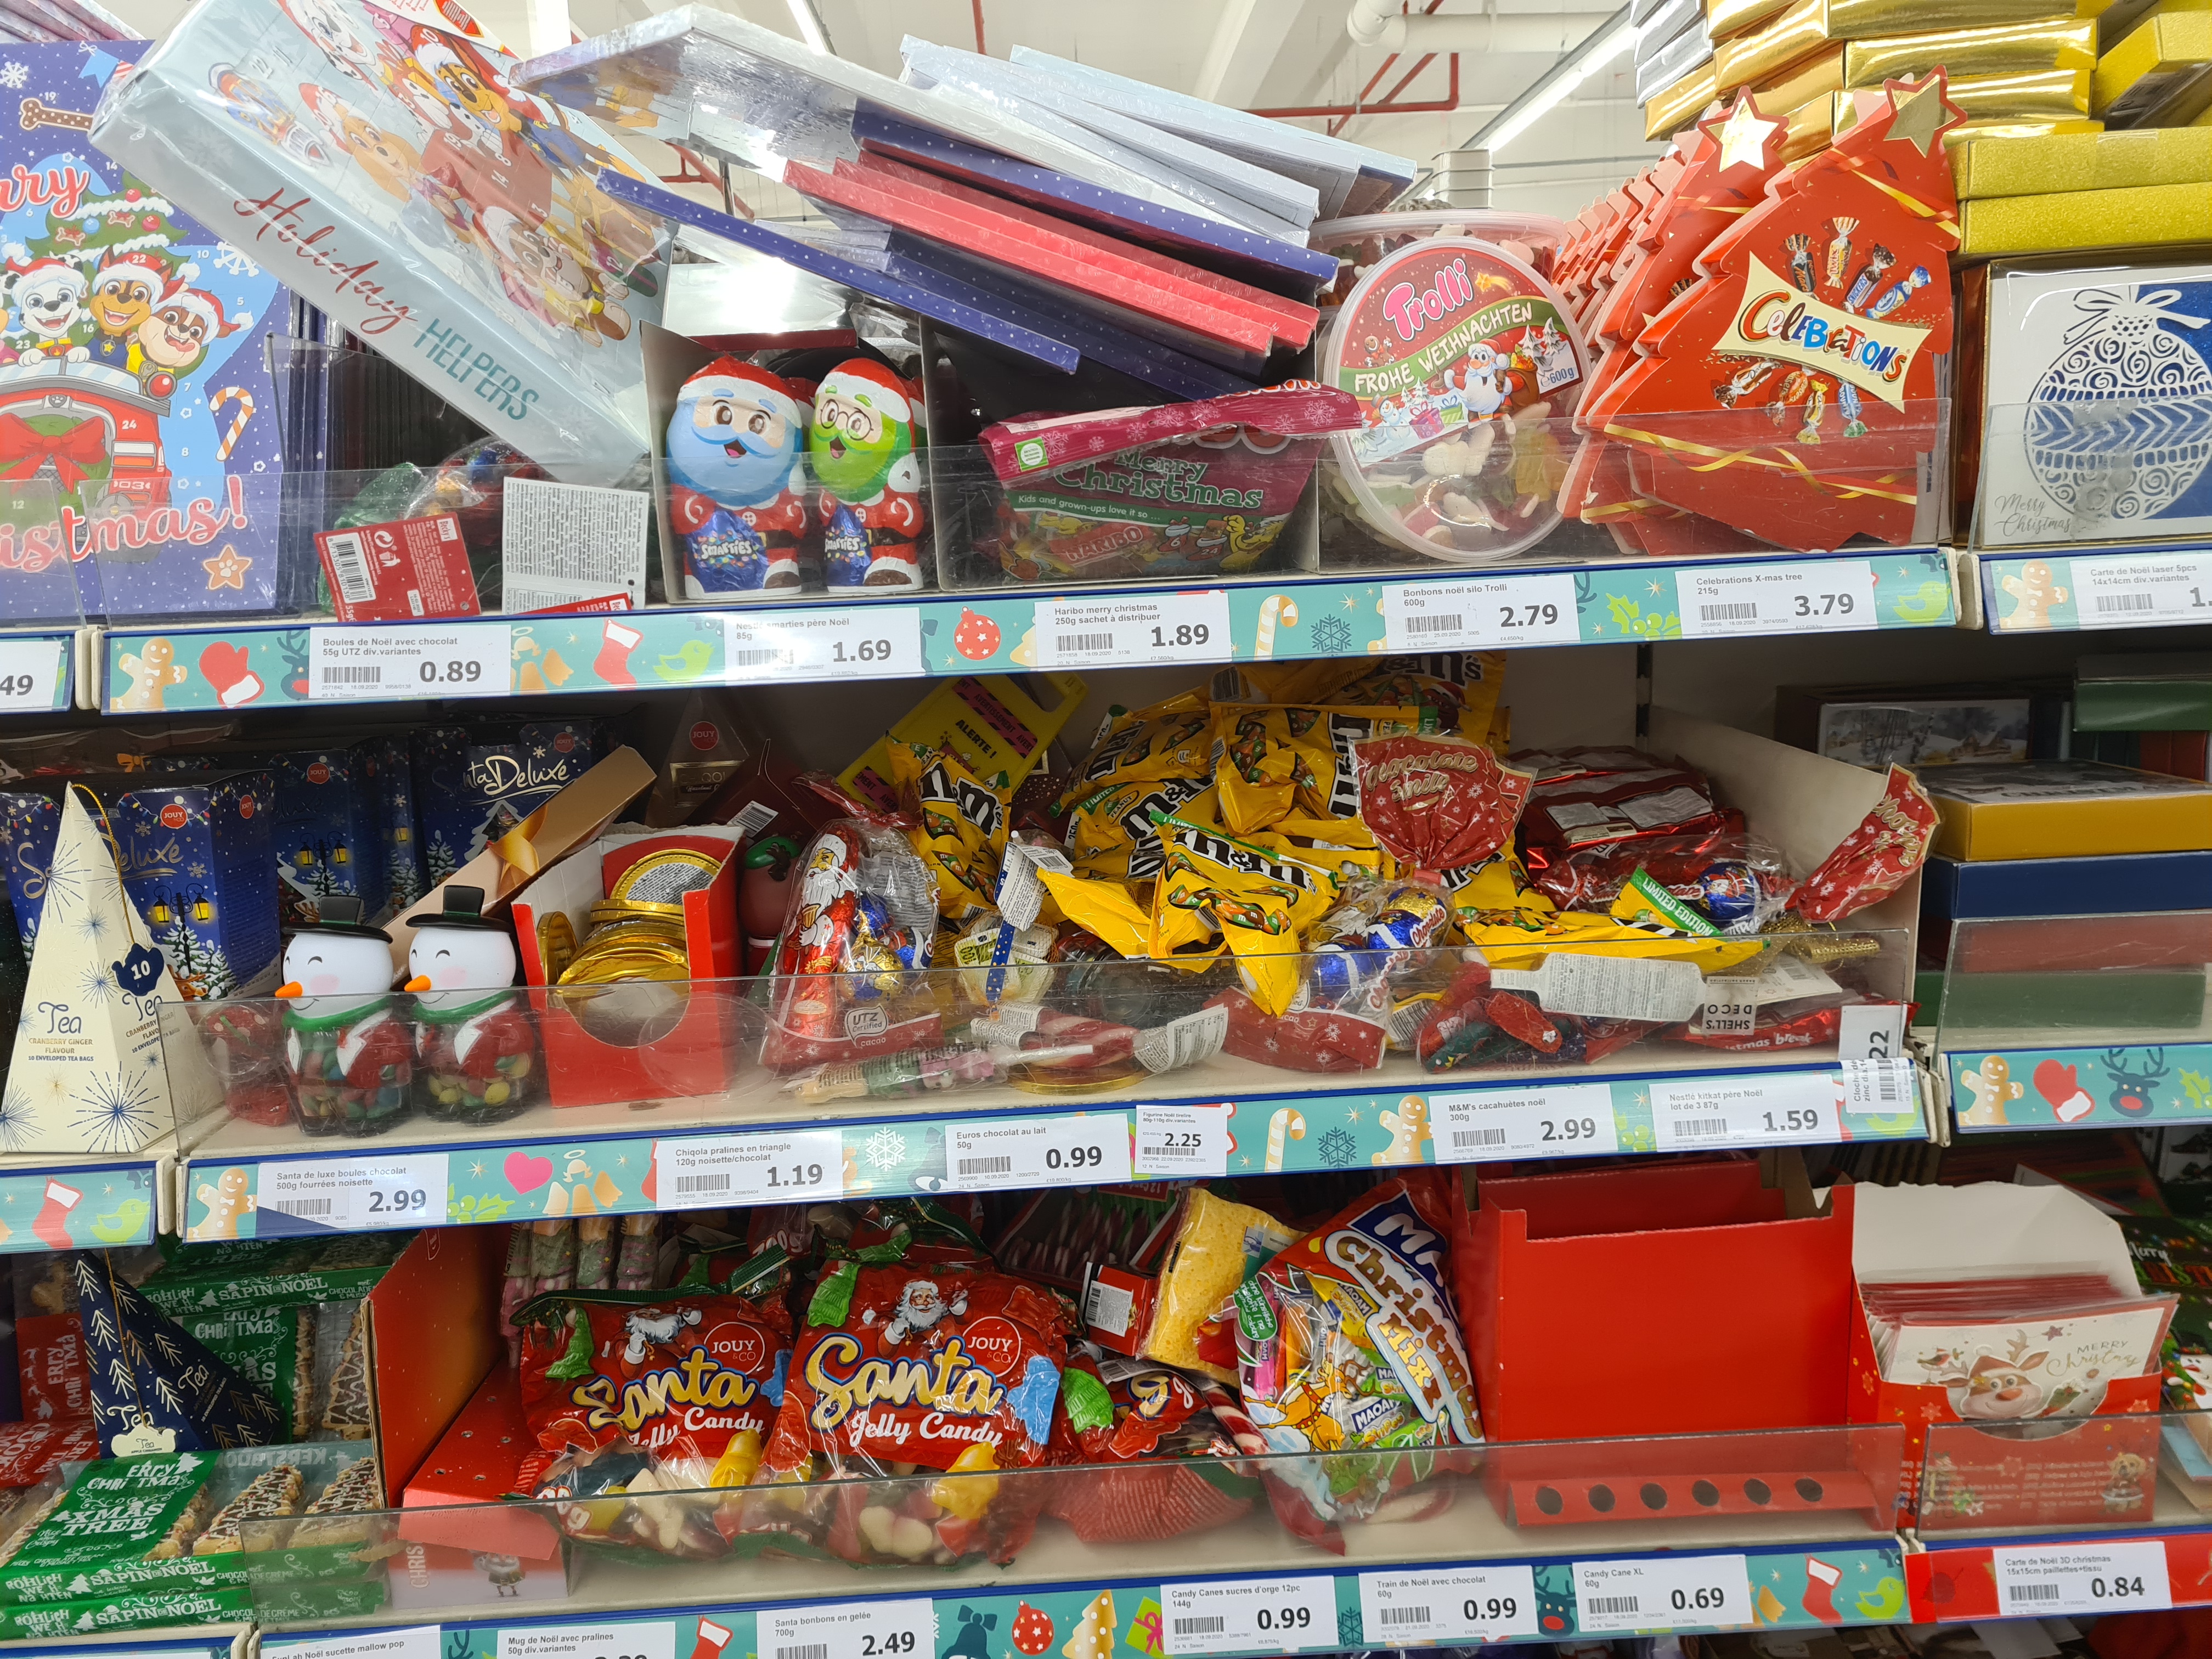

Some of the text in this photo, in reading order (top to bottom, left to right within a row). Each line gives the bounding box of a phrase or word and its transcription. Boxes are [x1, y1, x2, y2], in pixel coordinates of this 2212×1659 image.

[45, 91, 57, 102] 19
[132, 255, 146, 264] 22
[197, 250, 210, 259] 10
[234, 187, 419, 335] Holiday
[1384, 257, 1475, 341] Trolli
[1848, 274, 1867, 304] SNICKERS
[237, 297, 244, 306] 5
[82, 324, 94, 334] 16
[15, 340, 30, 349] 23
[1354, 301, 1533, 394] FROHE WEIHNACHTEN
[413, 318, 540, 421] HELPERS
[1549, 368, 1575, 383] 600g
[184, 382, 191, 392] 7
[122, 420, 137, 430] 24
[181, 448, 189, 456] 8
[1115, 453, 1208, 481] Merry
[1054, 466, 1265, 510] Christmas
[12, 500, 25, 509] 12
[1018, 494, 1148, 518] Kids and grown-ups love it so
[1995, 494, 2046, 515] Merry
[0, 474, 247, 567] istmas!
[439, 521, 451, 540] Becky's
[1995, 514, 2073, 533] Christmas
[1062, 526, 1145, 565] HARIBO
[1697, 575, 1752, 585] Celebrations
[1055, 605, 1157, 615] Haribo merry christmas
[1794, 593, 1853, 616] 3.79
[1500, 604, 1558, 627] 2.79
[1152, 624, 1209, 646] 1.89
[323, 648, 338, 657] 55g
[833, 639, 891, 662] 1.69
[420, 661, 481, 682] 0.89
[974, 693, 1015, 732] AVERTISSEMENT
[692, 729, 716, 739] JOUY
[163, 811, 184, 819] JOUY
[1109, 795, 1133, 819] PEANUT
[131, 961, 150, 980] 10
[38, 1002, 82, 1034] Tea
[851, 1012, 879, 1024] UTZ
[1707, 1005, 1752, 1014] DECO
[1706, 1020, 1750, 1029] SHELL'S
[860, 1036, 887, 1047] cacao
[1775, 1032, 1813, 1045] break
[1449, 1098, 1545, 1112] M&M's cacahuètes noël
[1450, 1114, 1469, 1122] 300g
[1763, 1109, 1818, 1132] 1.59
[984, 1129, 1019, 1137] chocolat
[1165, 1133, 1201, 1147] 2.25
[1541, 1118, 1596, 1141] 2.99
[676, 1148, 708, 1157] Chiqola
[710, 1147, 744, 1155] pralines
[760, 1143, 791, 1152] triangle
[676, 1154, 771, 1167] 120g noisette/chocolat
[1046, 1146, 1102, 1169] 0.99
[338, 1169, 366, 1177] boules
[370, 1167, 407, 1175] chocolat
[768, 1164, 823, 1187] 1.19
[276, 1178, 373, 1190] 500g fourrées noisette
[369, 1189, 426, 1212] 2.99
[219, 1274, 329, 1301] SAPIN NOËL
[710, 1339, 754, 1354] JOUY
[967, 1335, 1012, 1353] JOUY
[178, 1365, 210, 1396] Tea
[572, 1347, 759, 1431] Santa
[804, 1333, 1006, 1430] Santa
[684, 1407, 765, 1432] Candy
[849, 1411, 1003, 1449] Jelly Candy
[136, 1438, 154, 1448] Tea
[66, 1501, 166, 1523] XMAS
[61, 1516, 154, 1537] TREE
[90, 1560, 216, 1587] SAPIN NOËL
[1584, 1570, 1609, 1578] Candy
[1585, 1580, 1599, 1588] 60g
[1172, 1591, 1197, 1599] Candy
[1255, 1586, 1279, 1594] d'orge
[2091, 1577, 2145, 1598] 0.84
[1464, 1598, 1516, 1620] 0.99
[1671, 1588, 1724, 1610] 0.69
[96, 1597, 221, 1626] SAPIN NOËL
[1257, 1607, 1310, 1630] 0.99
[862, 1632, 915, 1656] 2.49
